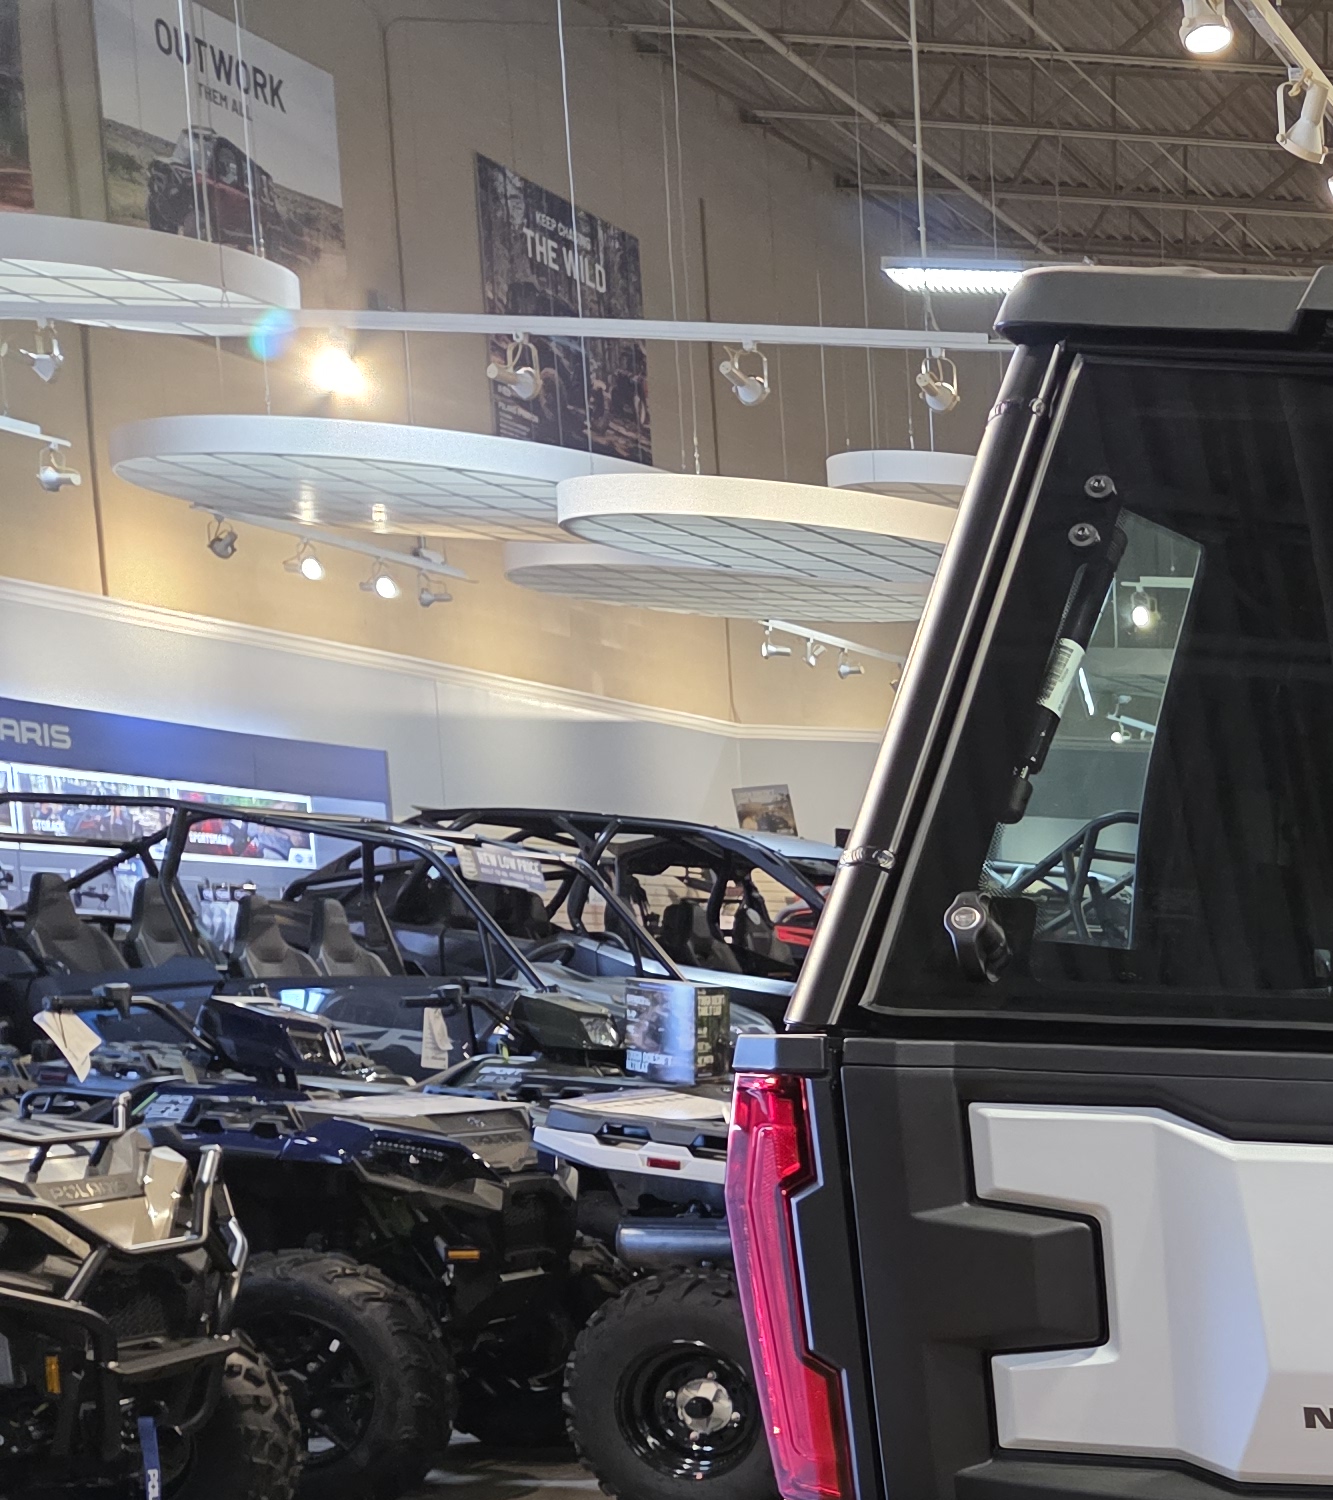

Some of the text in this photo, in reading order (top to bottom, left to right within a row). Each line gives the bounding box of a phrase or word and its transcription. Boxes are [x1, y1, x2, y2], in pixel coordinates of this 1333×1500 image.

[154, 17, 287, 114] OUTWORK
[197, 82, 253, 121] THEM ALL
[536, 211, 592, 251] KEEP CHAING
[522, 226, 606, 293] THE WILD
[477, 851, 541, 875] NEW LOW PRICE
[50, 1179, 128, 1199] POLARIS
